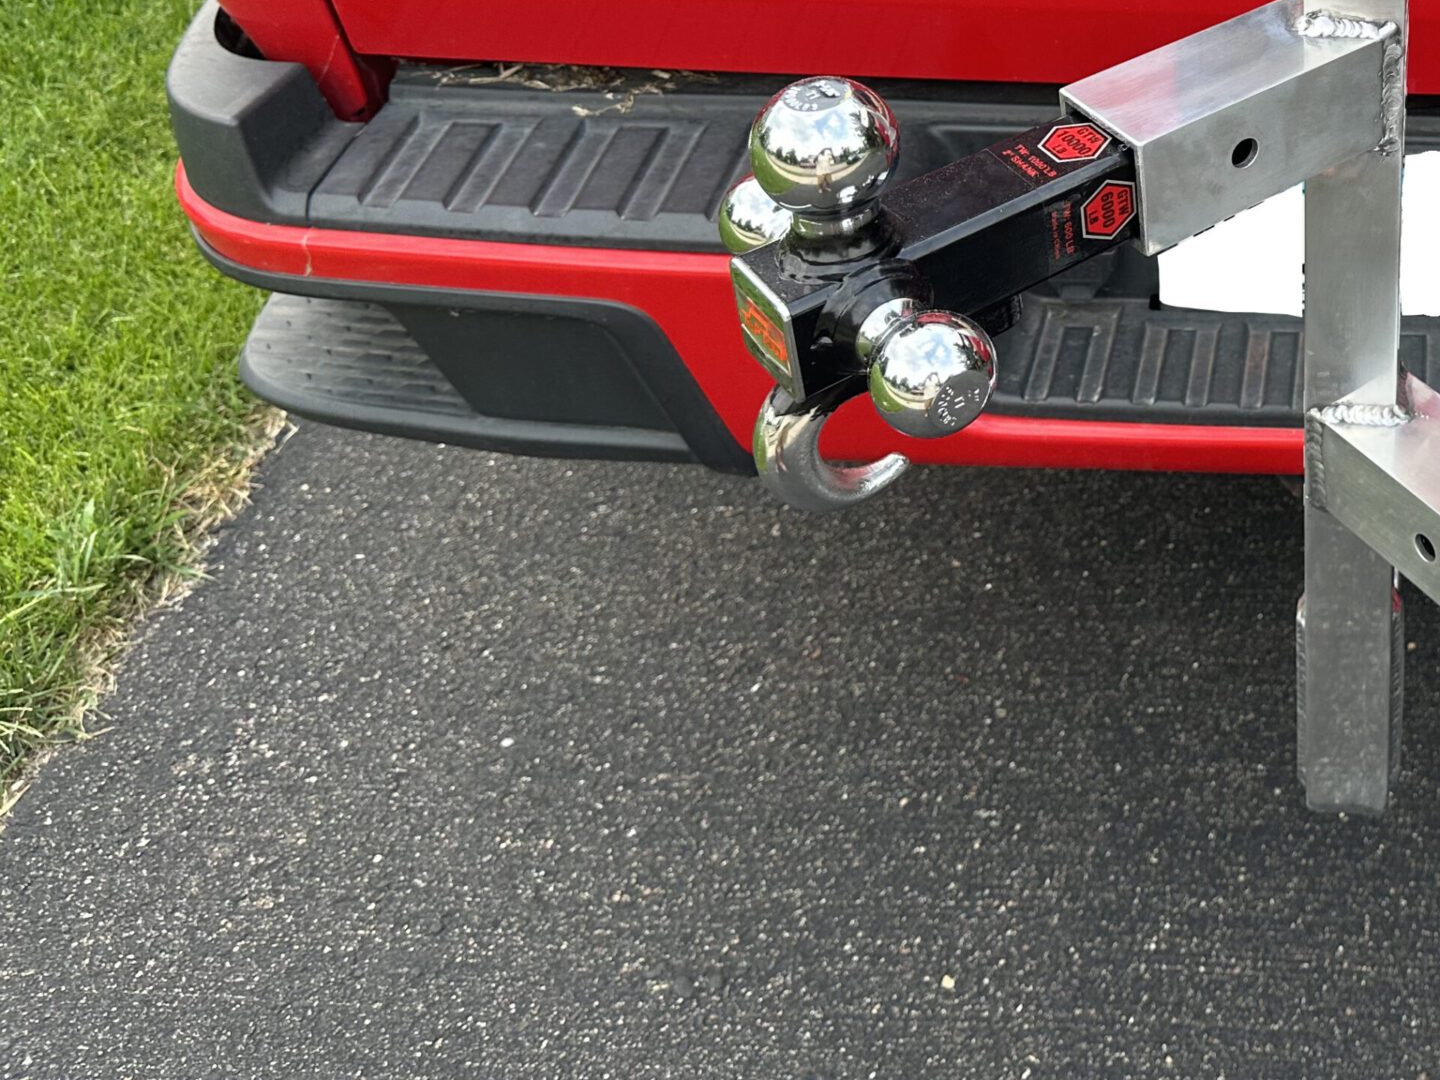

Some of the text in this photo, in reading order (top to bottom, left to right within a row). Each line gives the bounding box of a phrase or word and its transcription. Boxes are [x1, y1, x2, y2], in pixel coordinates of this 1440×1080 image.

[1056, 130, 1092, 155] 10000
[1076, 127, 1100, 144] GTW
[1052, 144, 1069, 155] LB
[1100, 191, 1116, 228] 6000
[1116, 188, 1130, 216] GTW
[1087, 210, 1099, 225] LB
[1066, 239, 1076, 256] LB
